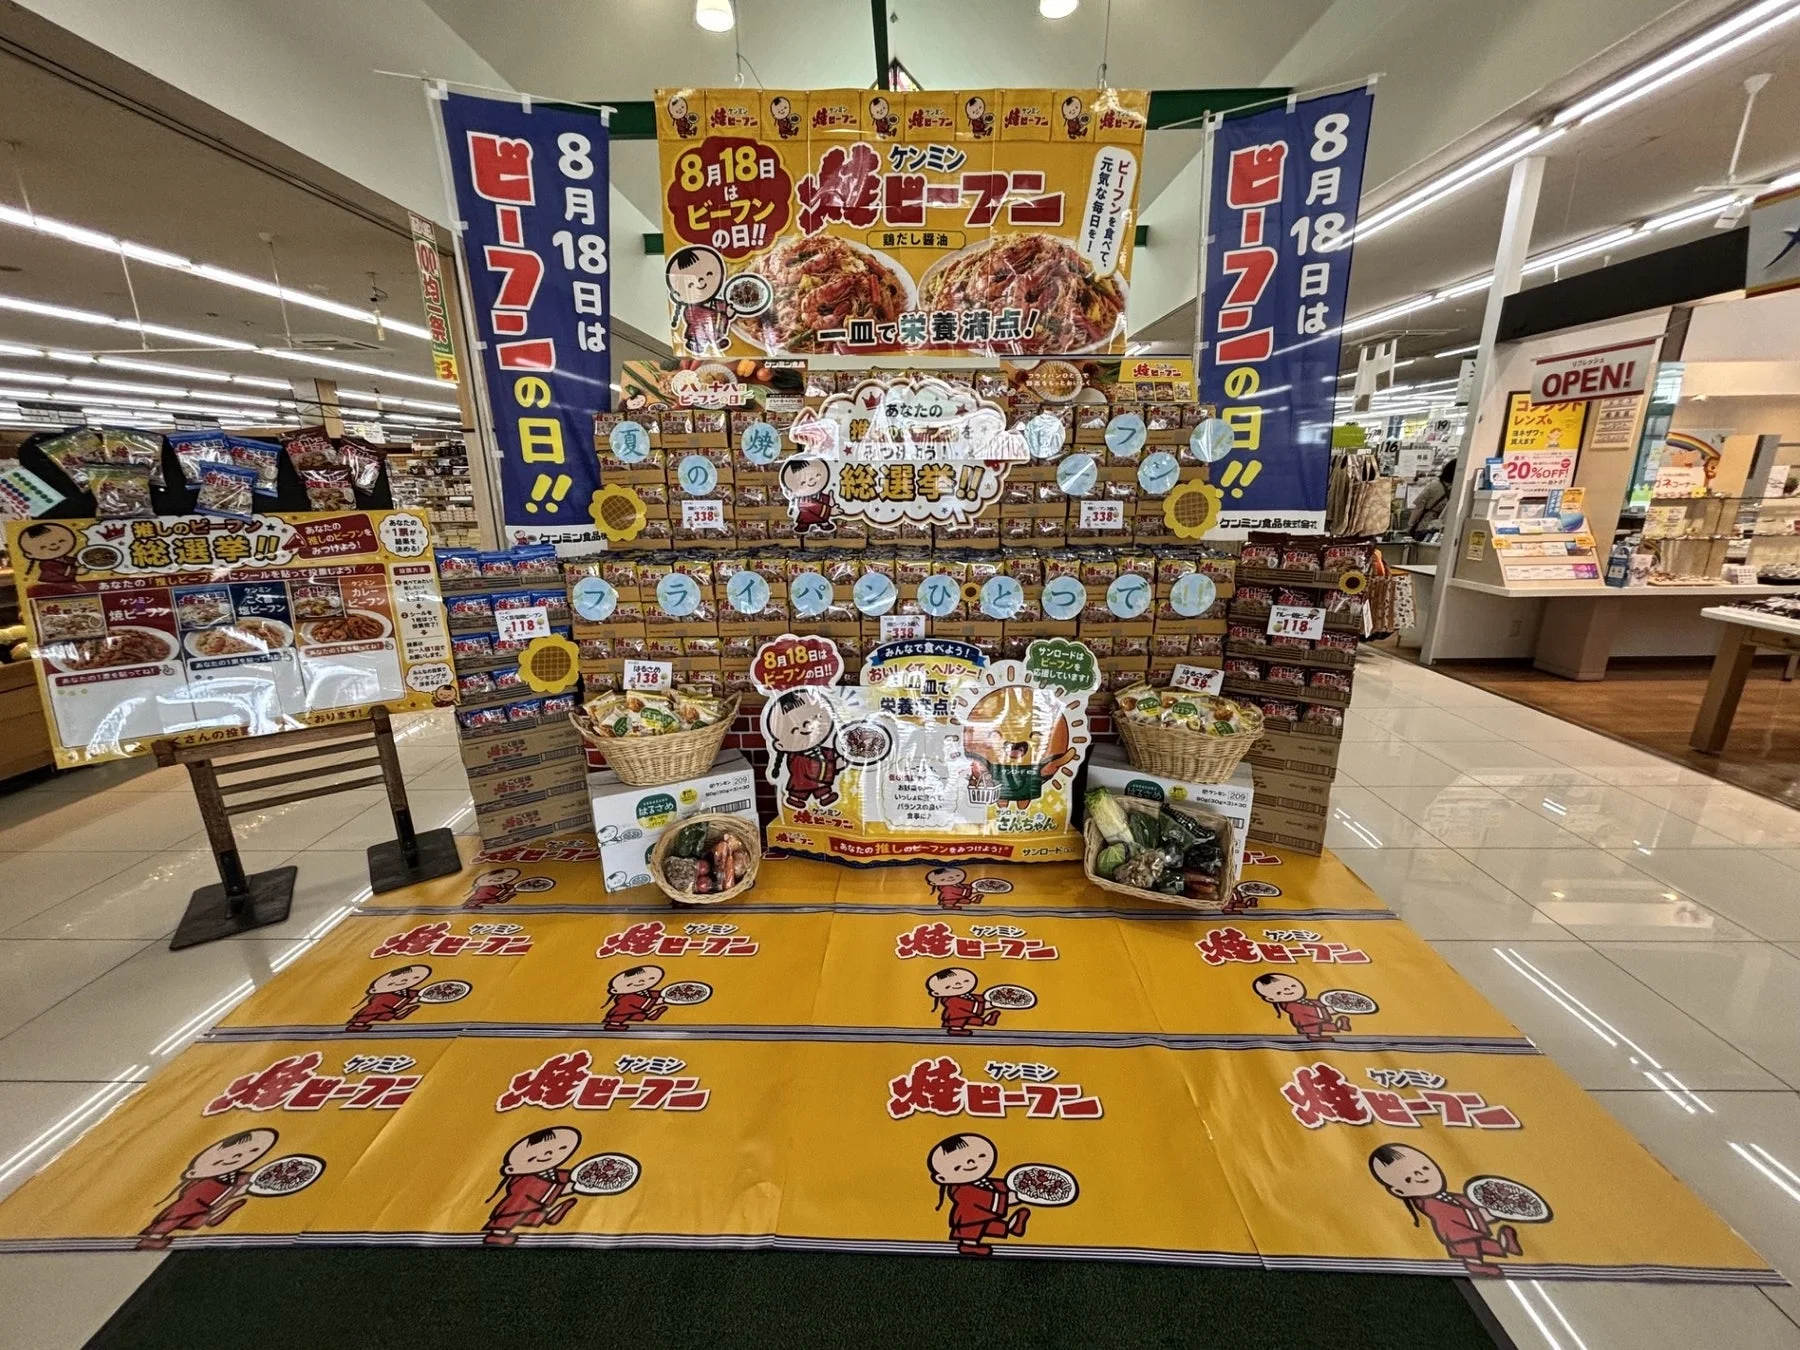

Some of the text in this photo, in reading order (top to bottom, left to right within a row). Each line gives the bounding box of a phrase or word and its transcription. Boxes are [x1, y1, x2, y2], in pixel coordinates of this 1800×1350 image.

[889, 145, 967, 171] ケンミン
[680, 145, 775, 193] 8月18日
[724, 186, 739, 201] は
[797, 143, 1066, 237] 焼ビーフン
[688, 198, 775, 231] ビーフン
[1290, 113, 1349, 335] 8月18日は
[552, 132, 608, 353] 8月18日は
[882, 232, 950, 248] 鶏だし醤油
[818, 309, 1038, 347] 一皿で栄養満点!
[1572, 357, 1604, 367] リフレッシュ
[1541, 361, 1637, 398] OPEN!
[886, 403, 943, 418] あなたの
[619, 428, 645, 458] 夏
[748, 429, 775, 460] 焼
[1385, 440, 1398, 453] 16
[687, 465, 709, 486] の
[389, 519, 418, 527] あなたの
[694, 511, 714, 522] 338
[1092, 511, 1113, 522] 338
[1220, 518, 1318, 530] ケンミン食品株式会社
[131, 518, 263, 540] 推しのビーフン
[305, 522, 342, 535] あなたの
[307, 528, 373, 546] 推しのビーフンを
[352, 587, 380, 598] カレー
[120, 597, 154, 605] ケンミン
[348, 597, 386, 608] ビーフン
[238, 604, 286, 616] 塩ビーフン
[511, 620, 535, 633] 118
[892, 627, 914, 639] 338
[1283, 619, 1309, 632] 118
[763, 645, 828, 669] 8月18日は
[885, 641, 971, 658] みんなで食べよう!
[1038, 647, 1085, 661] サンロードは
[633, 665, 661, 673] はるさめ
[1041, 658, 1081, 671] ビーフンを
[637, 672, 659, 684] 138
[1185, 676, 1208, 688] 138
[733, 776, 748, 785] 209
[1229, 791, 1246, 800] 209
[638, 802, 675, 816] はるさめ
[812, 808, 842, 816] ケンミン
[793, 809, 854, 830] 焼ビーフン
[996, 816, 1057, 832] さんちゃん
[468, 922, 525, 935] ケンミン
[684, 922, 739, 935] ケンミン
[969, 925, 1026, 937] ケンミン
[1263, 929, 1321, 942] ケンミン
[371, 921, 534, 959] 焼ビーフン
[596, 920, 760, 959] 焼ビーフン
[895, 922, 1060, 961] 焼ビーフン
[1195, 926, 1372, 966] 焼ビーフン
[344, 1055, 417, 1074] ケンミン
[615, 1055, 686, 1074] ケンミン
[984, 1061, 1058, 1081] ケンミン
[202, 1051, 425, 1117] 焼ビーフン
[495, 1050, 711, 1113] 焼ビーフン
[1366, 1067, 1448, 1088] ケンミン
[887, 1056, 1104, 1120] 焼ビーフン
[1280, 1062, 1524, 1129] 焼ビーフン
